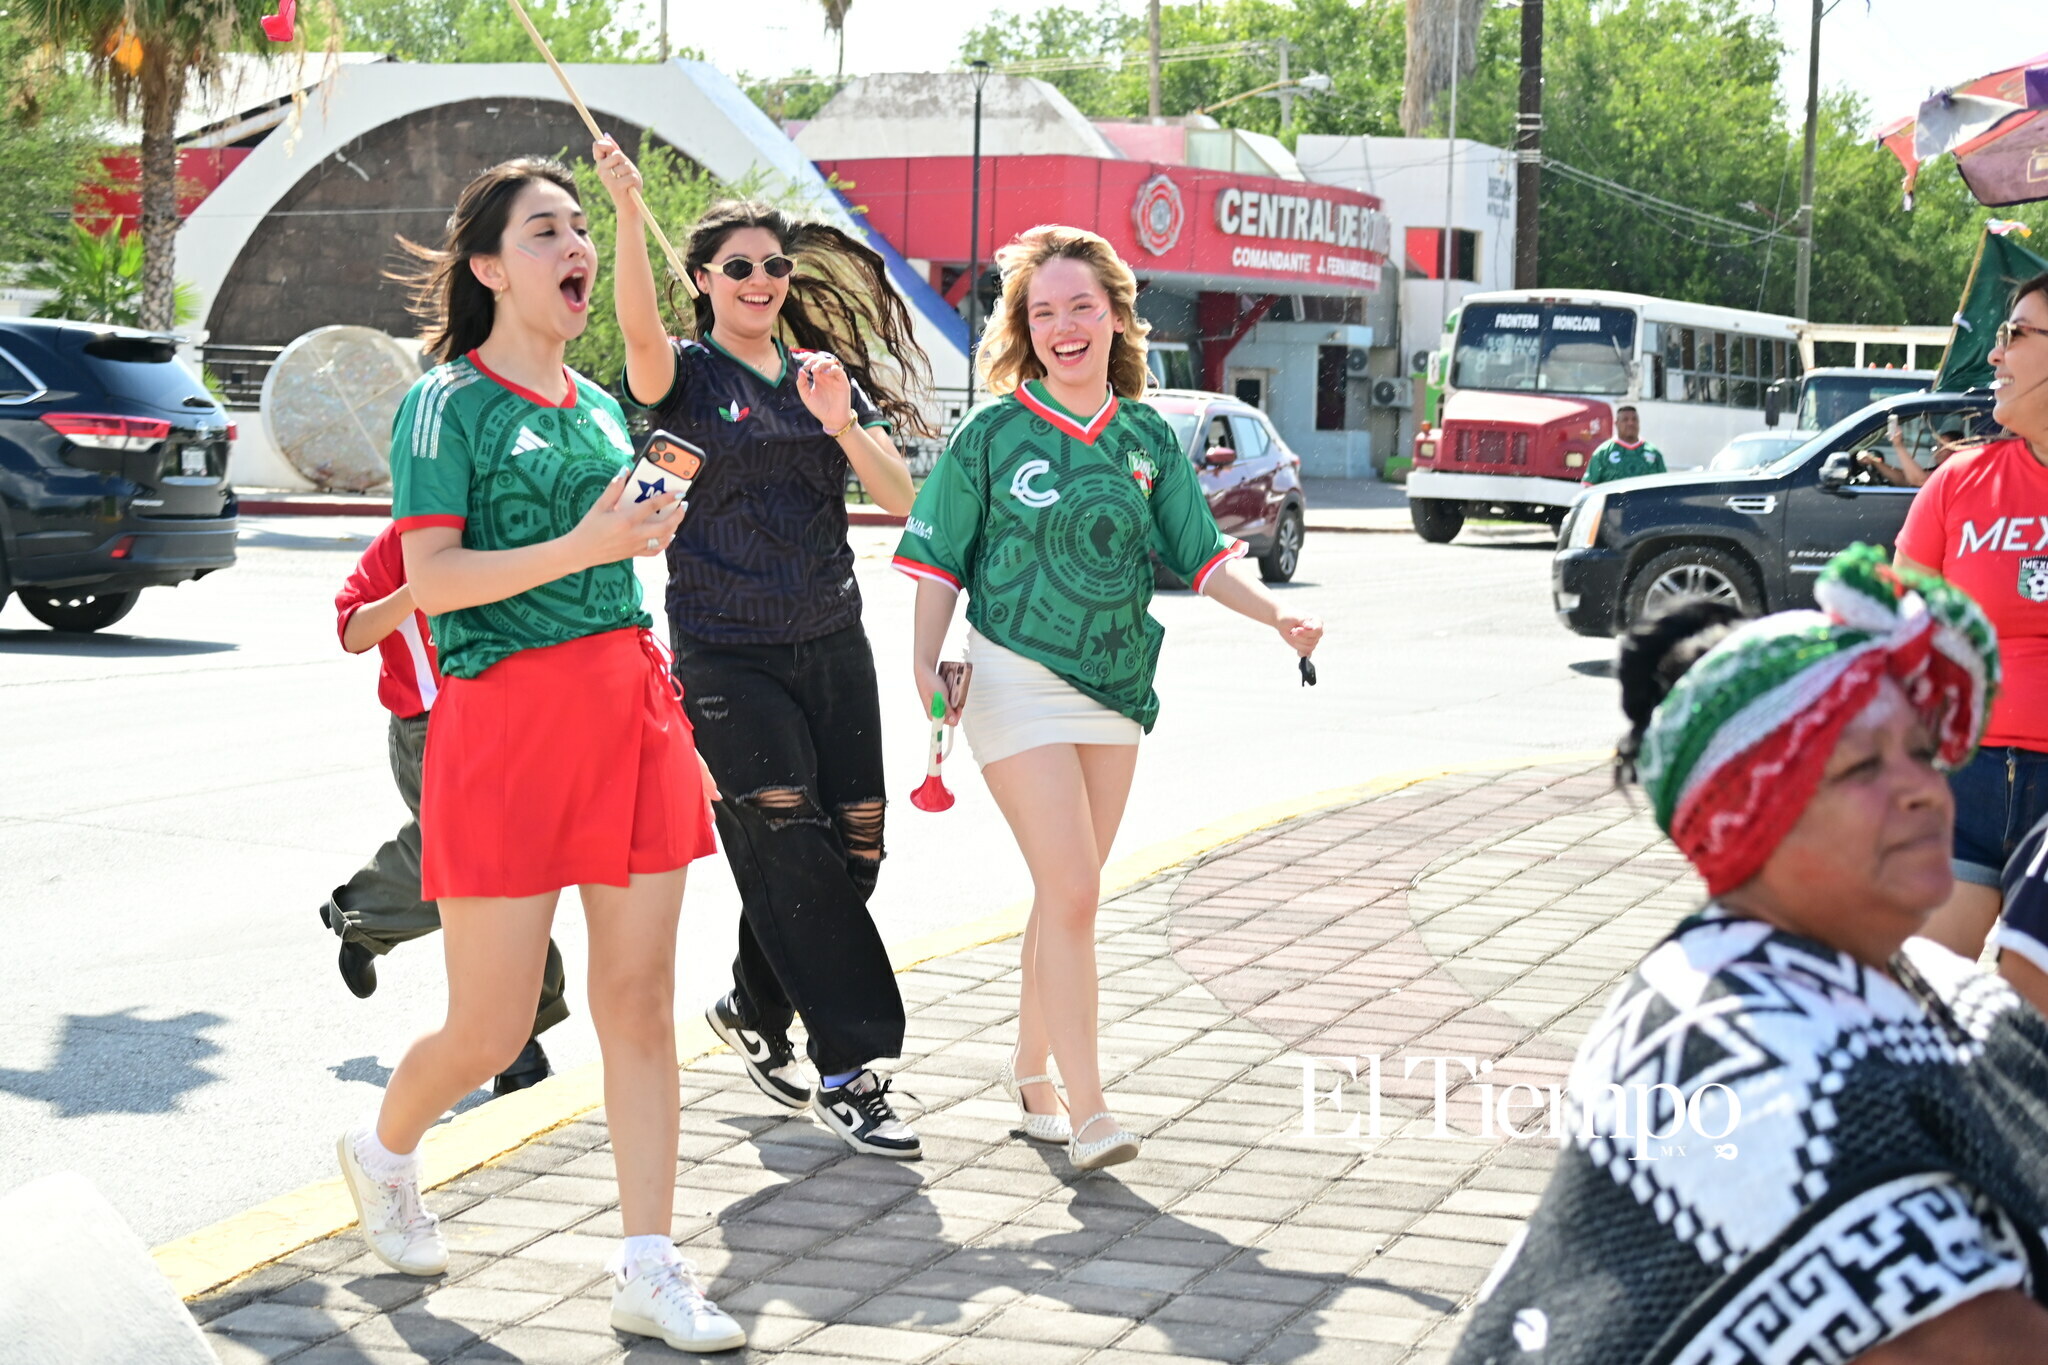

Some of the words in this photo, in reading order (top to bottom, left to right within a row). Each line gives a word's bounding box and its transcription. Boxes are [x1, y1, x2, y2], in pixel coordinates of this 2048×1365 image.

[1219, 188, 1336, 243] CENTRAL
[1338, 204, 1359, 247] DE
[1232, 247, 1312, 273] COMANDANTE
[1494, 313, 1540, 329] FRONTERA
[1551, 315, 1601, 331] MONCLOVA
